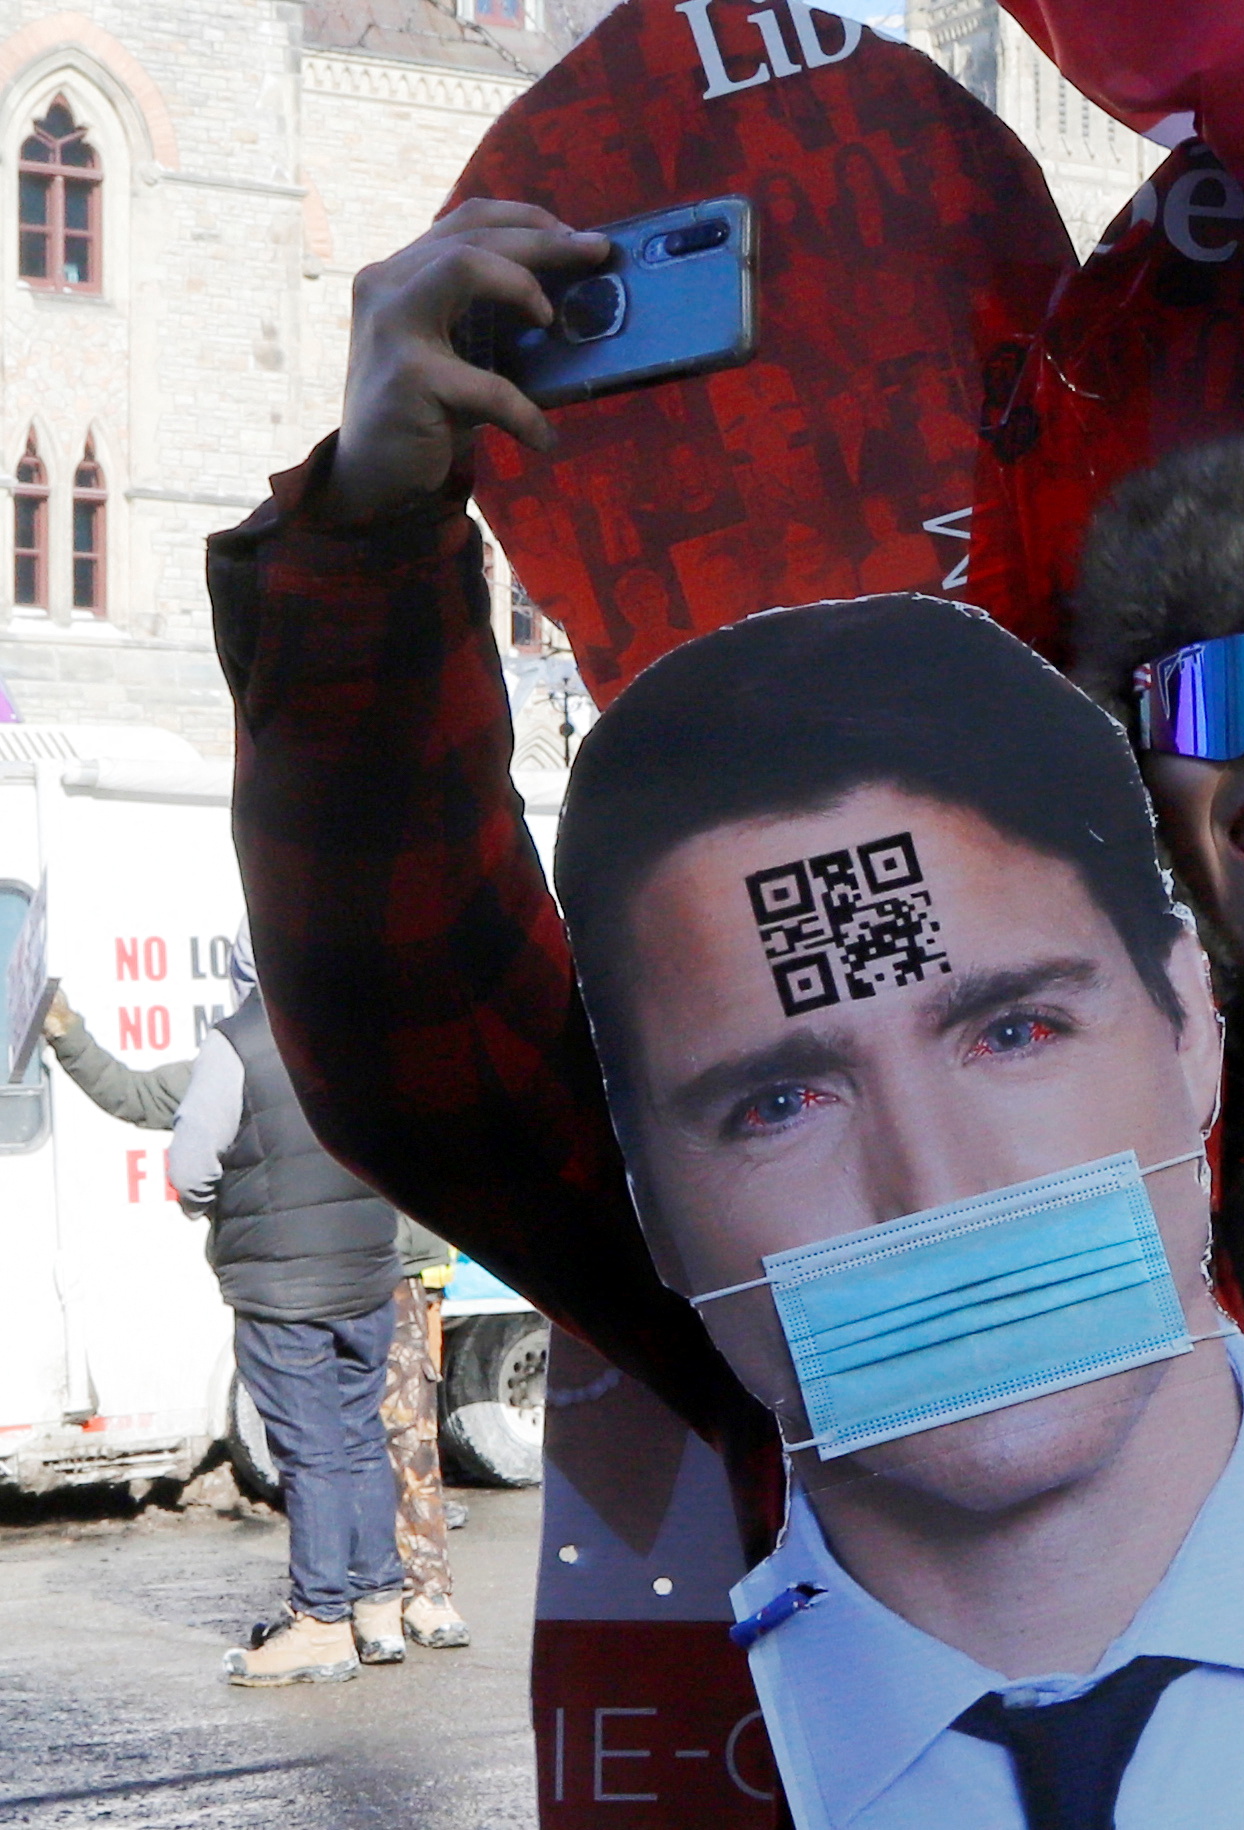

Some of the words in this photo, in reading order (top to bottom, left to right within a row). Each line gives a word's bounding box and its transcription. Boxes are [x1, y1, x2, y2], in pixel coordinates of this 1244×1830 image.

[115, 935, 168, 982] NO
[190, 935, 233, 980] LO
[118, 1004, 171, 1051] NO
